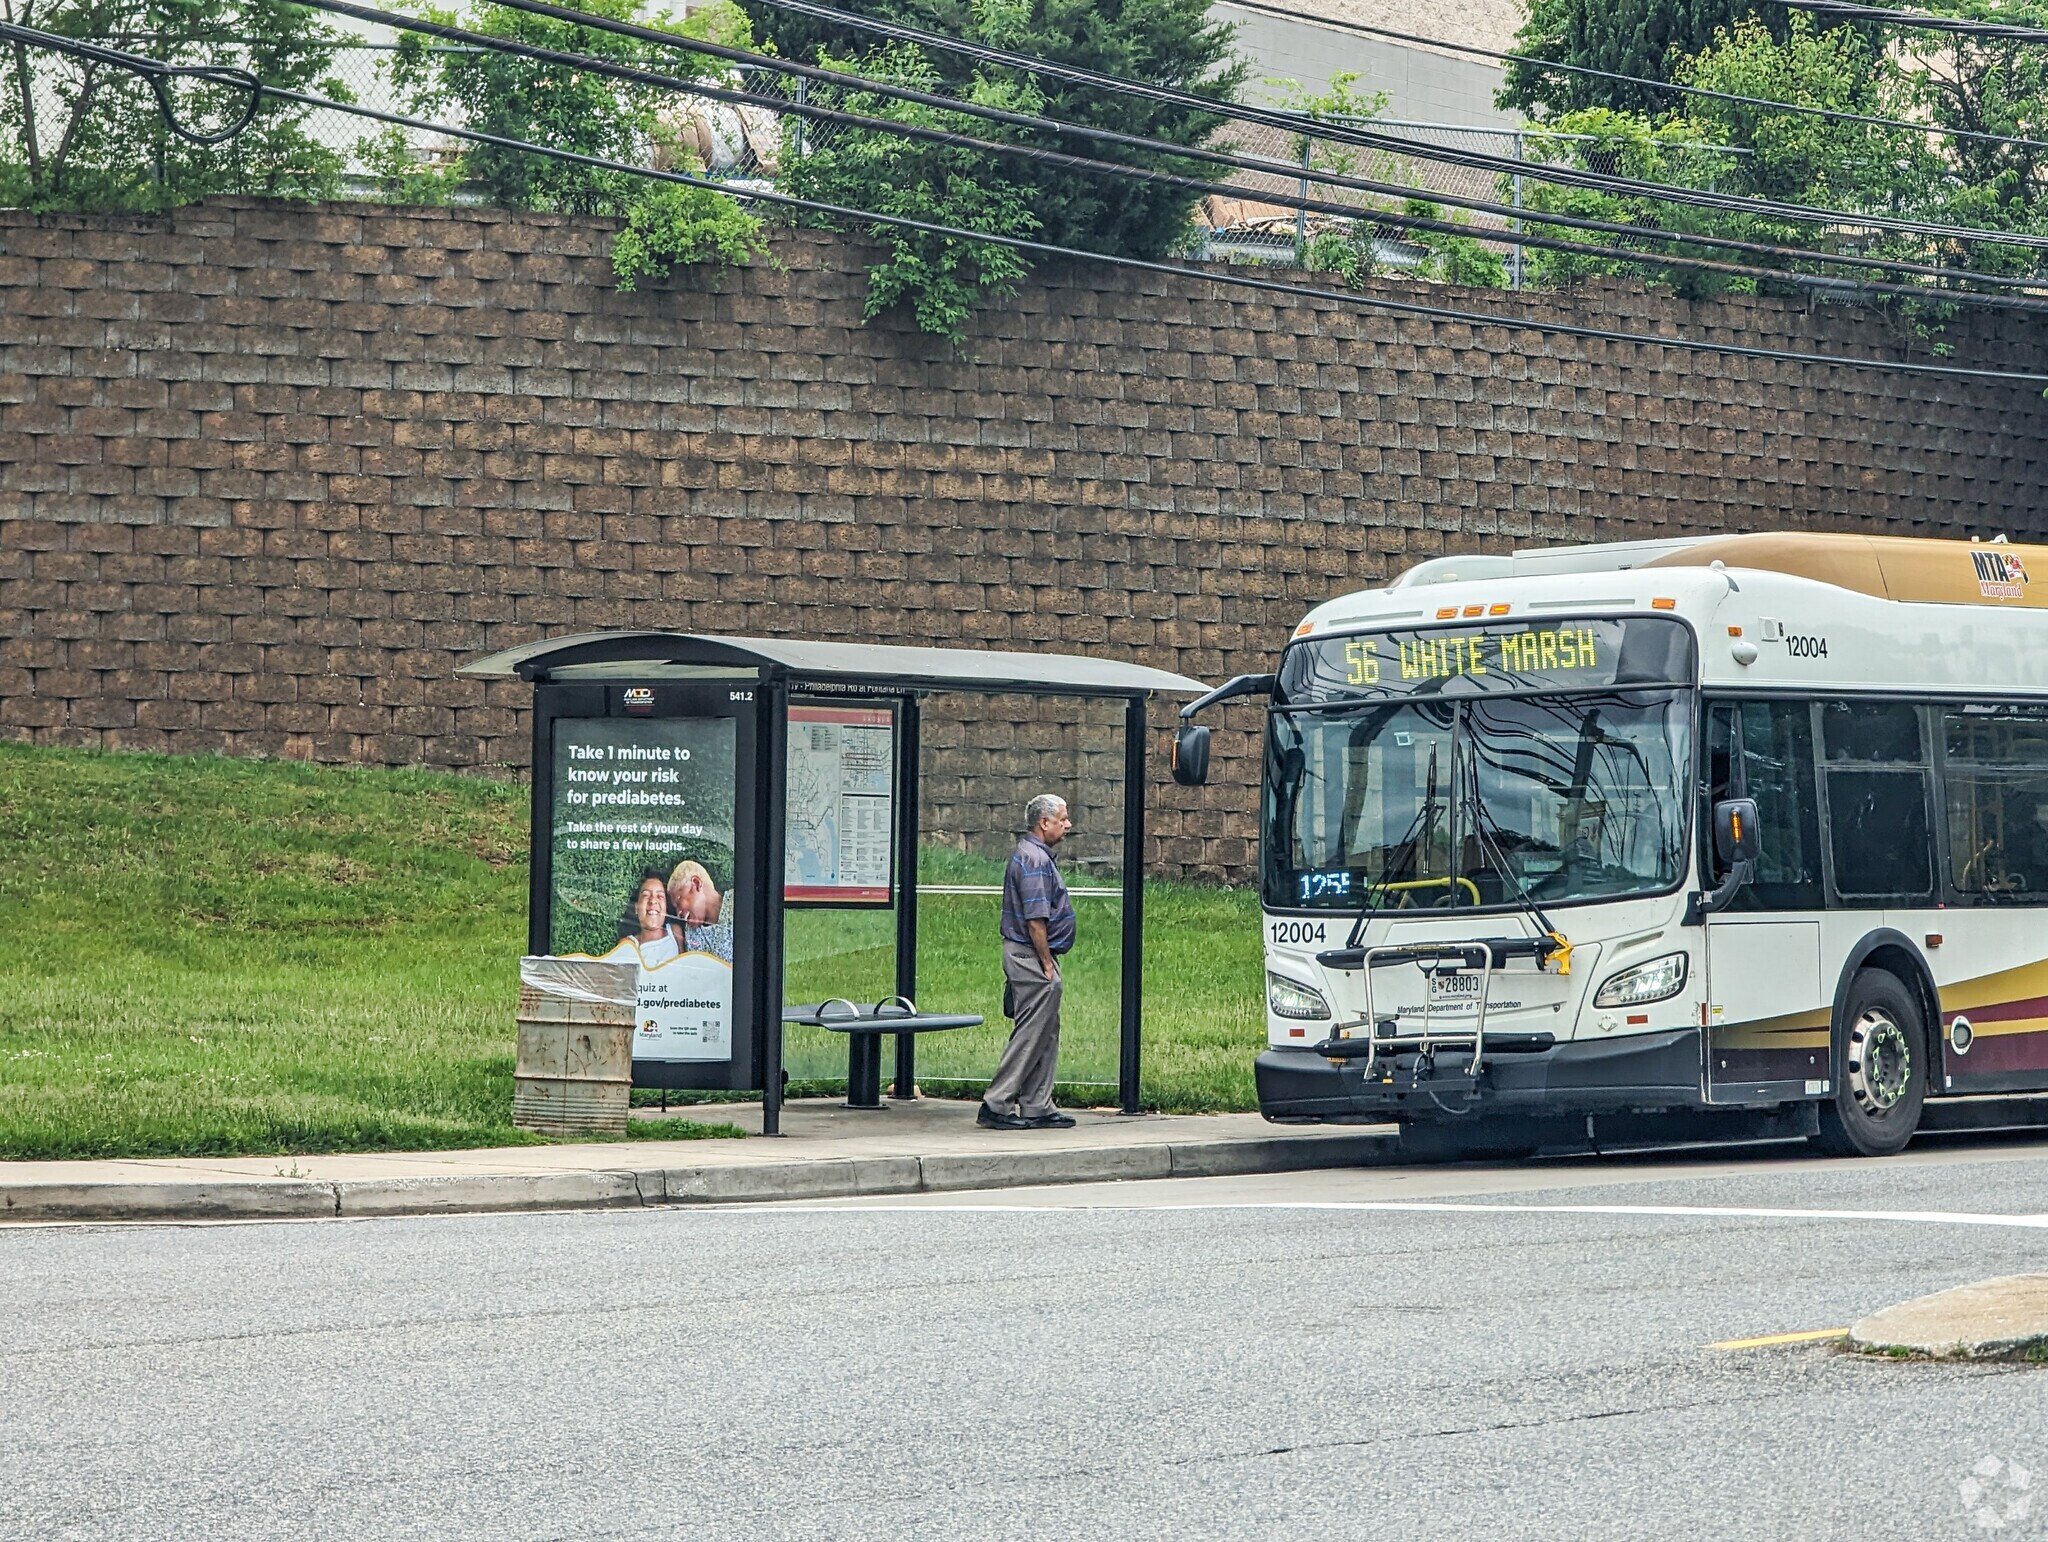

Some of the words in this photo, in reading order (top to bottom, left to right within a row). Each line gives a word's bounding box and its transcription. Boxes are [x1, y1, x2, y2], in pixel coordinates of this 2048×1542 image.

[1970, 552, 2010, 582] MTA
[1785, 635, 1829, 659] 12004
[1345, 641, 1380, 685] 56
[1400, 637, 1488, 679] WHITE
[1501, 629, 1597, 673] MARSH
[729, 691, 753, 701] 541.2
[568, 745, 604, 760] Take
[608, 745, 614, 760] 1
[617, 744, 671, 760] minute
[674, 747, 691, 760] to
[568, 767, 610, 782] know
[613, 771, 648, 785] your
[651, 767, 680, 783] risk
[567, 789, 588, 804] for
[592, 789, 685, 807] prediabetes.
[567, 822, 593, 832] Take
[595, 822, 614, 833] the
[616, 824, 638, 833] rest
[640, 823, 653, 834] of
[654, 825, 679, 836] your
[682, 823, 703, 836] day
[567, 839, 578, 849] to
[580, 839, 610, 849] share
[613, 841, 620, 850] a
[622, 839, 643, 850] few
[645, 840, 686, 852] laughs.
[1271, 922, 1327, 943] 12004
[638, 983, 656, 993] quiz
[658, 984, 668, 993] at
[1445, 976, 1479, 993] 28803
[1397, 1005, 1425, 1015] Maryland
[1428, 1003, 1463, 1013] Department
[1466, 1001, 1473, 1010] of
[1475, 1000, 1522, 1010] Tnsportation
